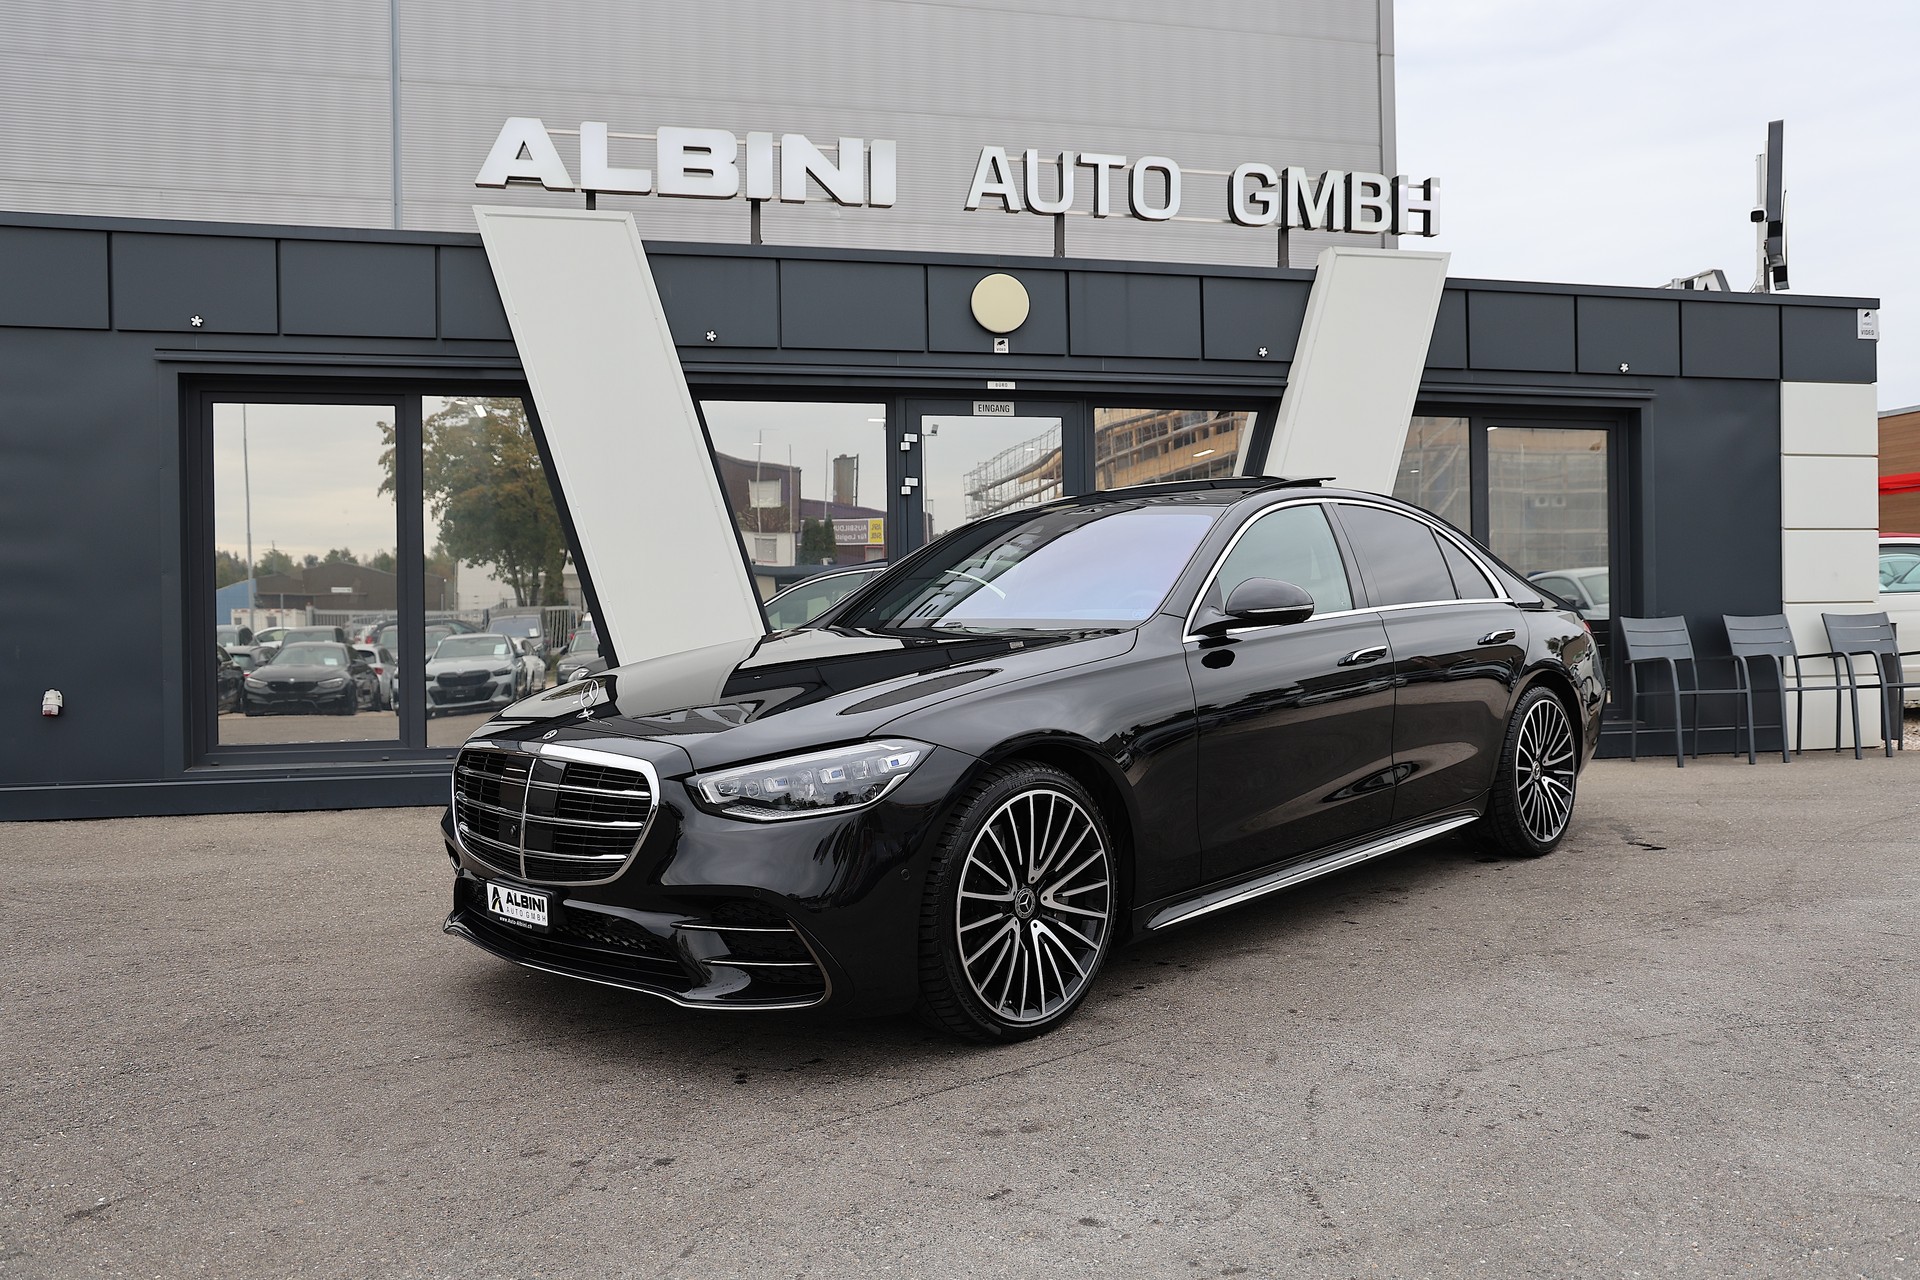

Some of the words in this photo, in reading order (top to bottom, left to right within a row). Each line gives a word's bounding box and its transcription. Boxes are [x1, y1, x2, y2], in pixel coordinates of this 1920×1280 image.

[474, 116, 897, 208] ALBINI
[963, 146, 1182, 221] AUTO
[1227, 162, 1441, 237] GMBH
[978, 404, 1010, 413] EINGANG
[506, 891, 545, 913] ALBINI
[506, 906, 524, 917] AUTO
[526, 911, 546, 922] GMBH
